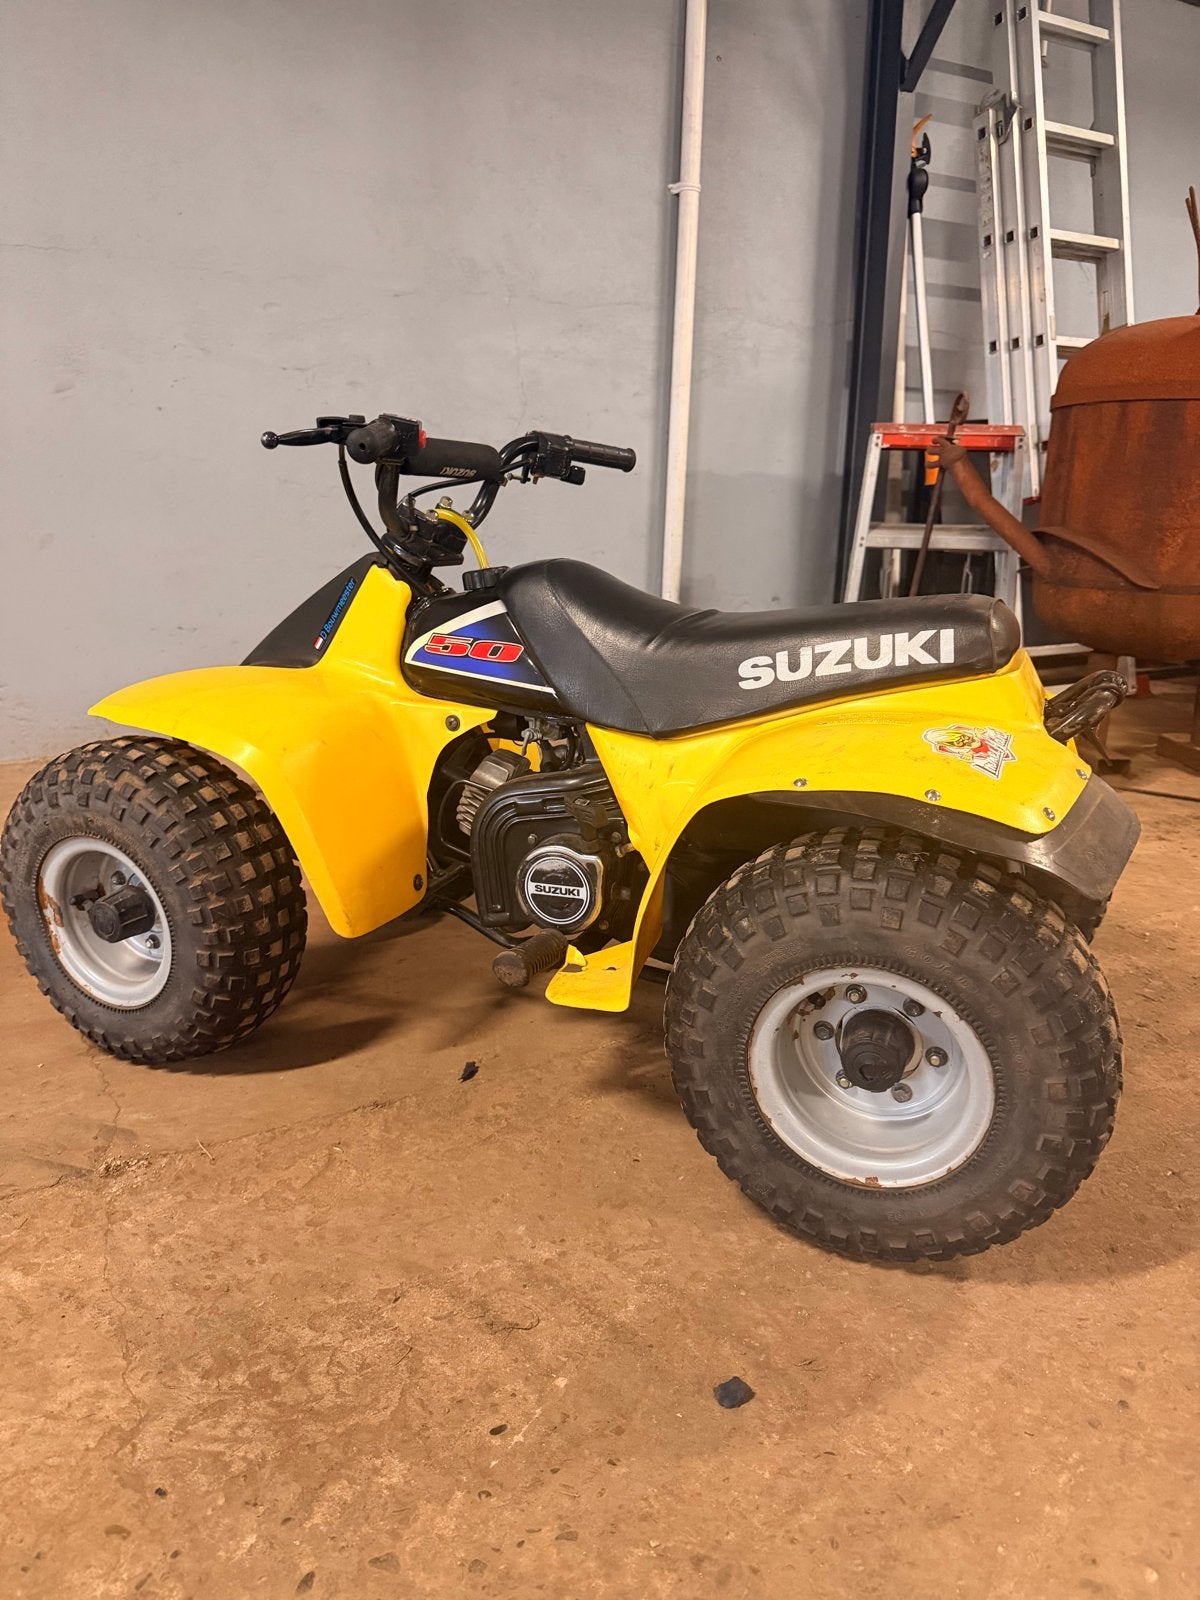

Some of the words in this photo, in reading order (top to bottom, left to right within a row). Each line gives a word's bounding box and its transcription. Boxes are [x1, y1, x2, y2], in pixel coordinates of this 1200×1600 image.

[440, 466, 478, 478] SUZUKI
[320, 630, 328, 641] D
[324, 578, 355, 633] Bouwmeester
[424, 632, 524, 663] 50
[738, 628, 955, 690] SUZUKI
[534, 884, 581, 897] SUZUKI
